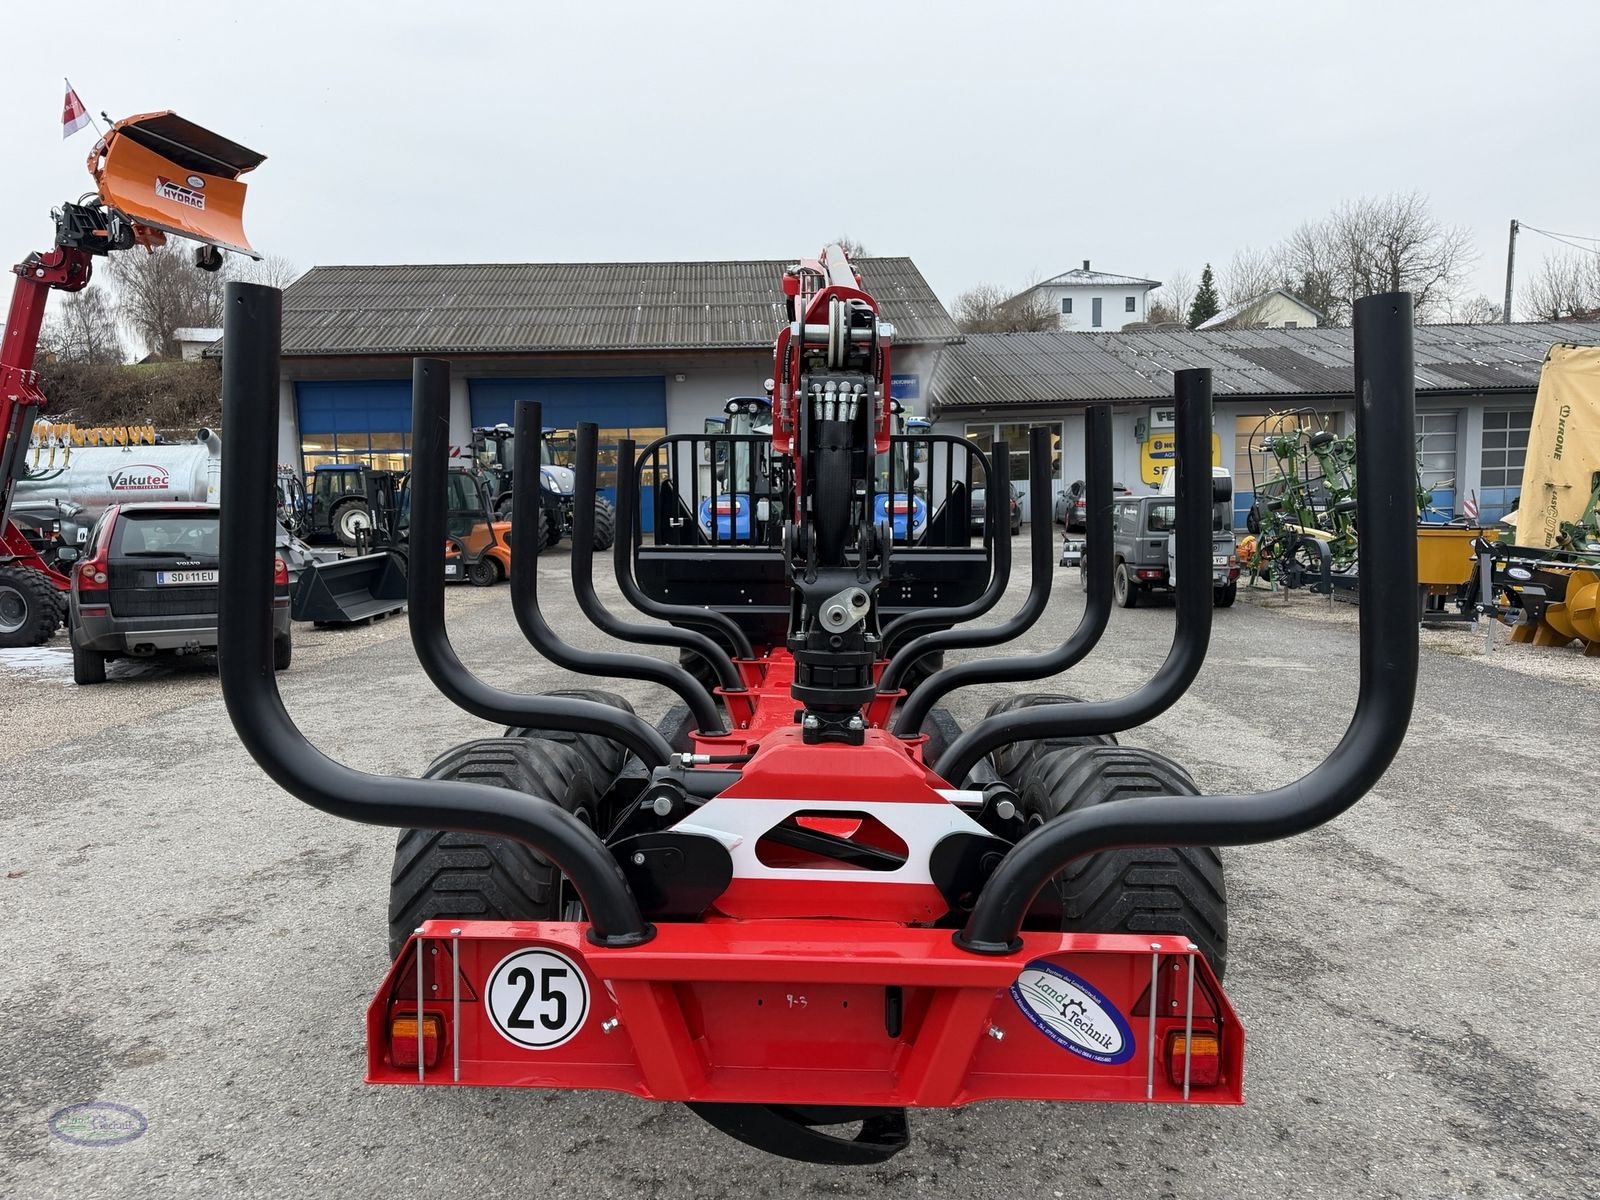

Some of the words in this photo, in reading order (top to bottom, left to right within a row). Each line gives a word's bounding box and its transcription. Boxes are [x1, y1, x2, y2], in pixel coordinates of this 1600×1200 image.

[163, 188, 204, 209] HYDRAC
[1156, 411, 1175, 422] FE
[1553, 418, 1566, 461] KRONE
[107, 471, 169, 490] Vakutec
[171, 572, 184, 582] SD
[507, 966, 568, 1030] 25
[1034, 976, 1069, 1003] Land
[1067, 1010, 1113, 1050] Technik
